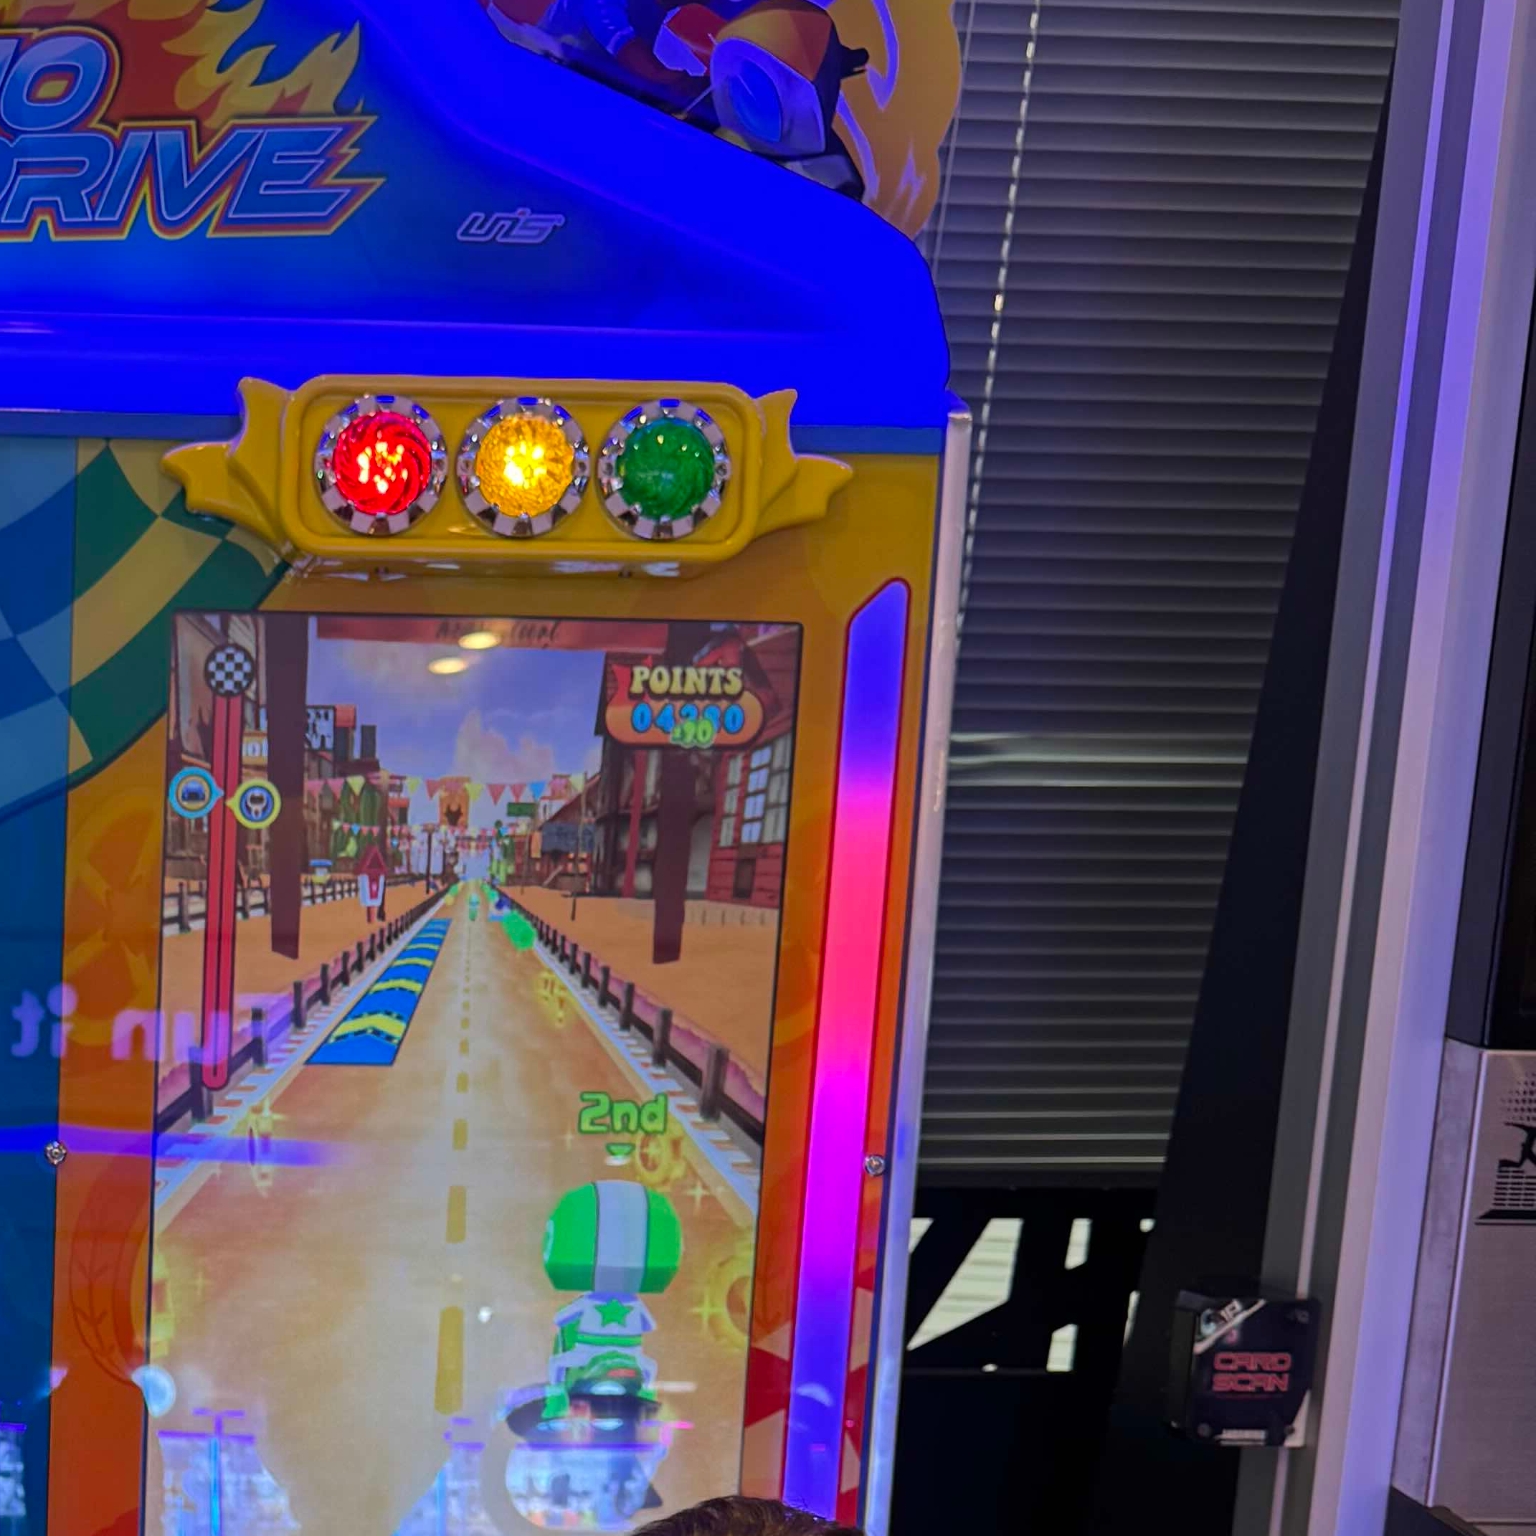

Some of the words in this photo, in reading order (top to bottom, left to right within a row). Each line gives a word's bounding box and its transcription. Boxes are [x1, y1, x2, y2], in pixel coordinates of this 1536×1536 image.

[630, 666, 743, 696] POINTS
[578, 1091, 668, 1134] 2nd
[1214, 1352, 1292, 1372] CARD
[1211, 1373, 1290, 1392] SCAN
